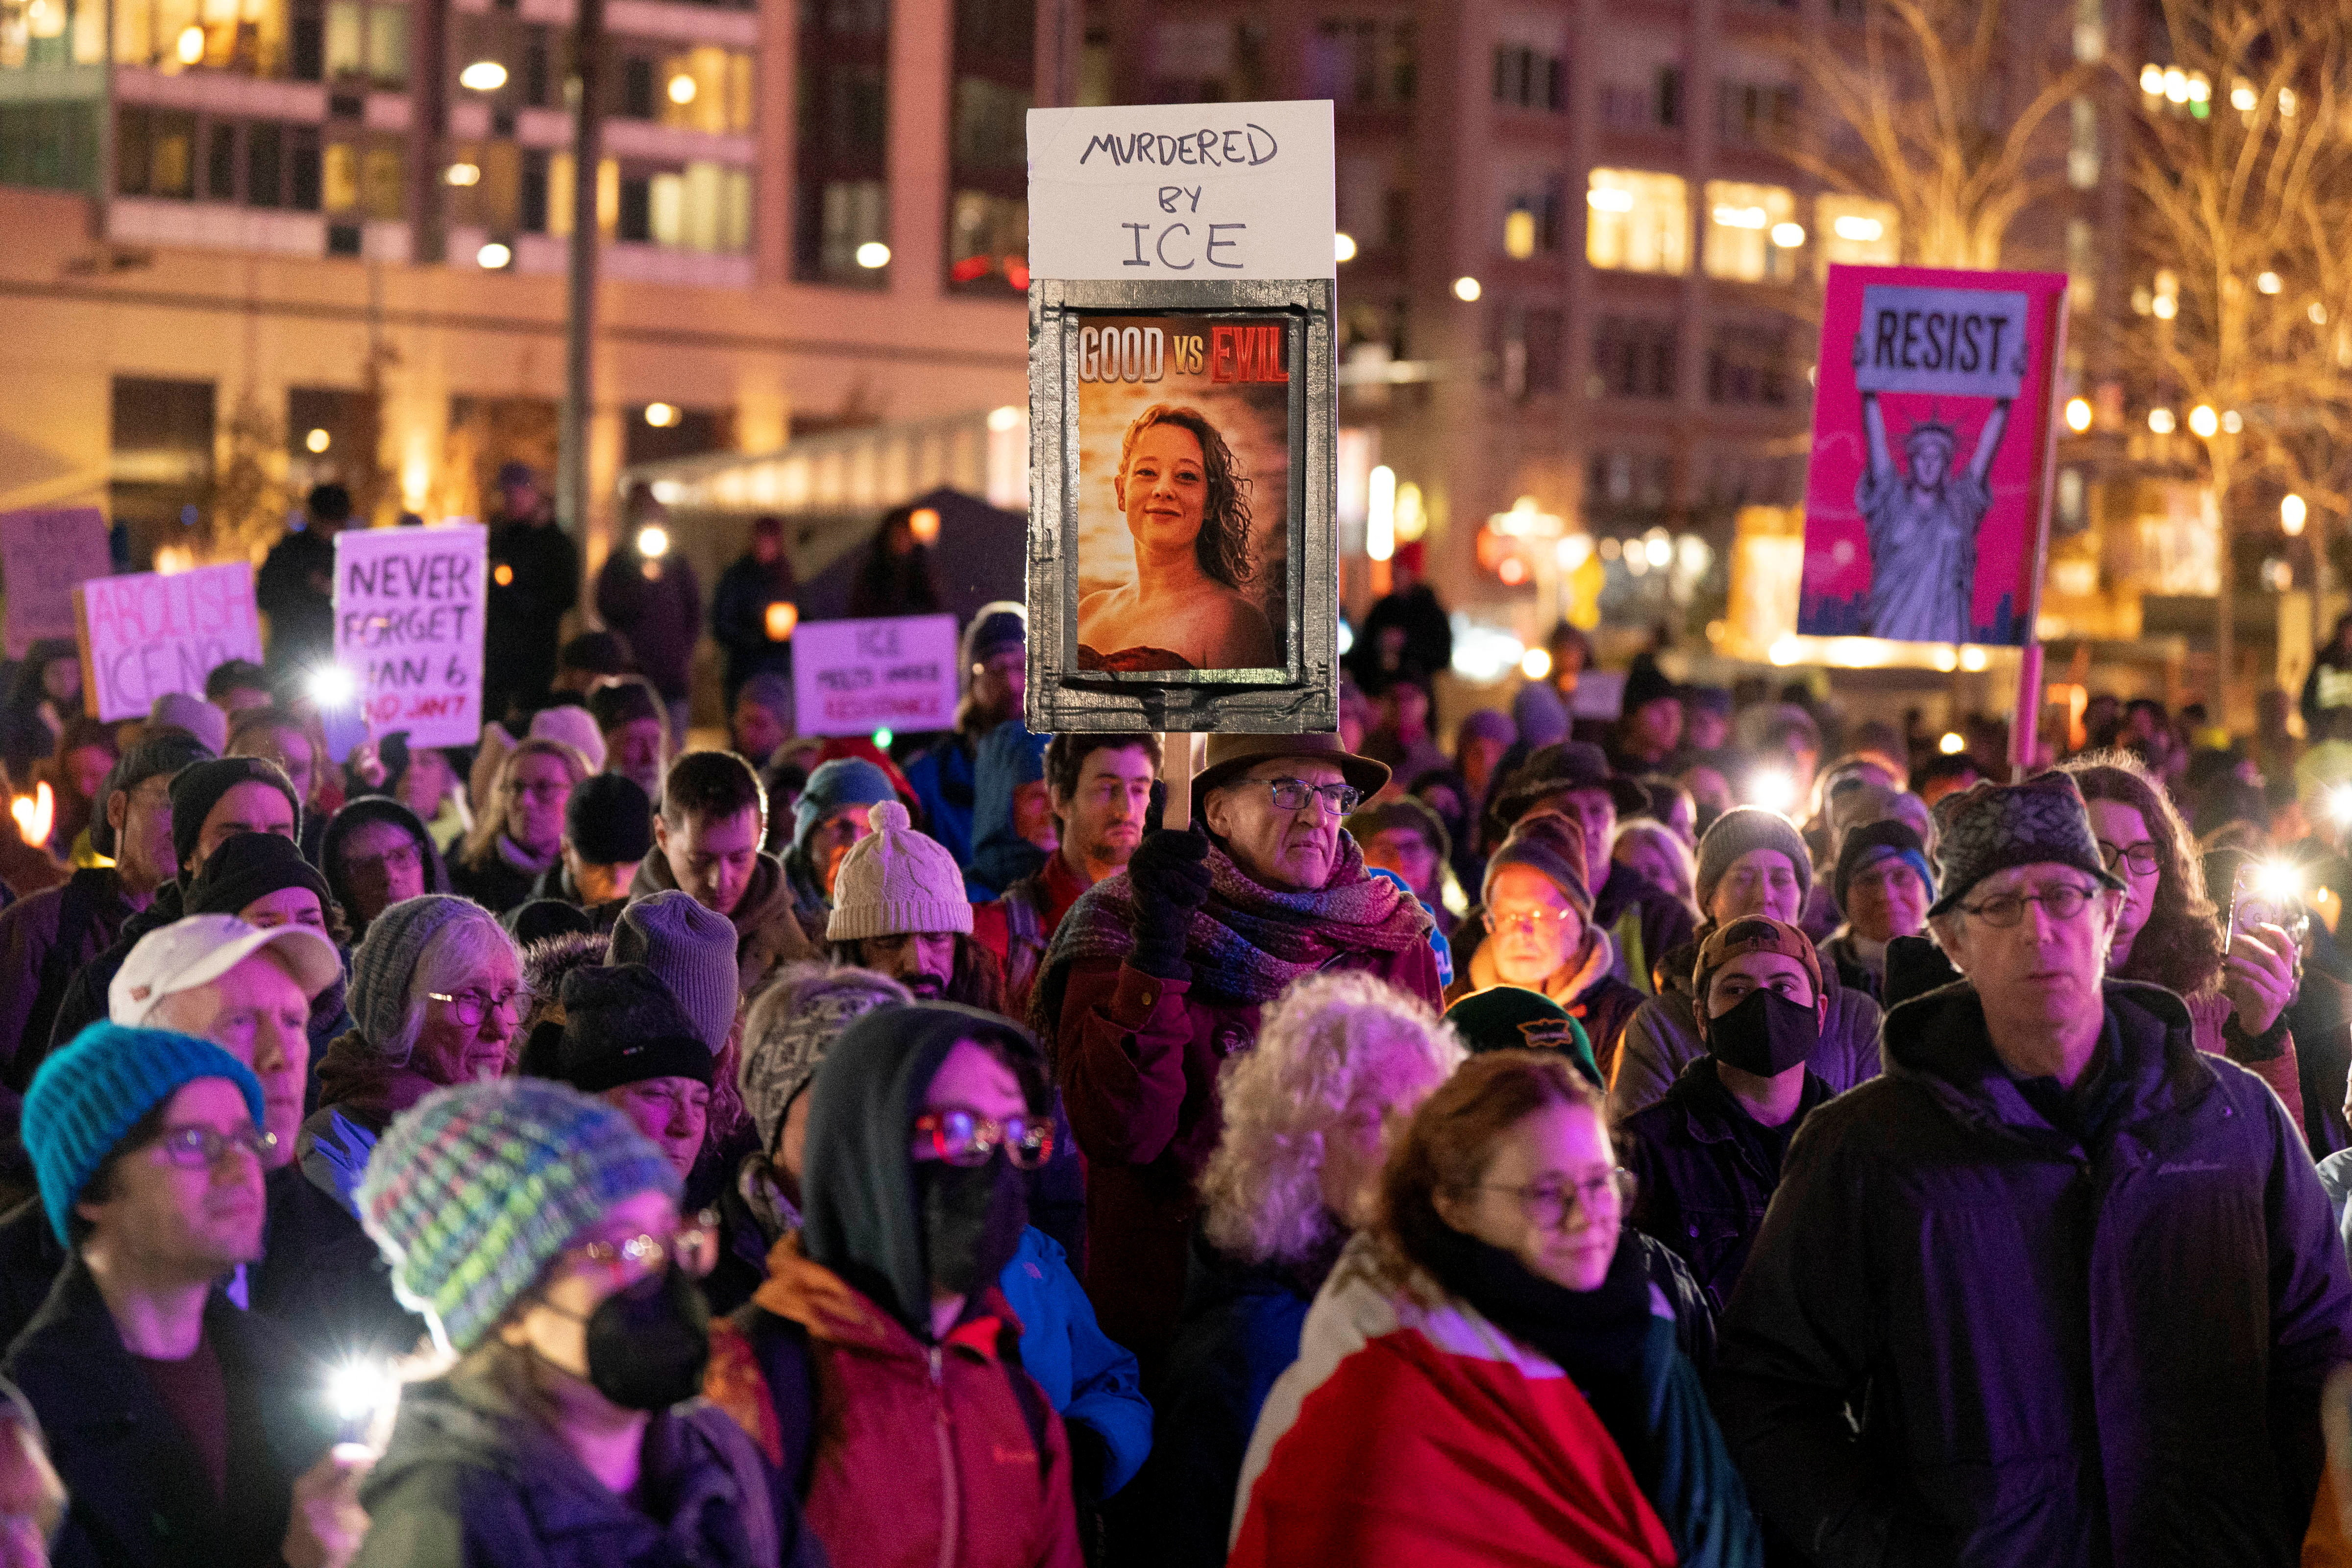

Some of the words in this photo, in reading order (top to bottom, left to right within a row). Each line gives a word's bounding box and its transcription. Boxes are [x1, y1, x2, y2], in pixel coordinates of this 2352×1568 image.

[1080, 123, 1277, 167] MURDERED
[1158, 185, 1202, 214] BY
[1122, 223, 1247, 270] ICE
[1079, 326, 1164, 383] GOOD
[1211, 326, 1289, 384] EVIL
[1875, 310, 2009, 375] RESIST
[348, 553, 471, 599] NEVER
[343, 604, 471, 649] FORGET
[444, 654, 468, 686] 6
